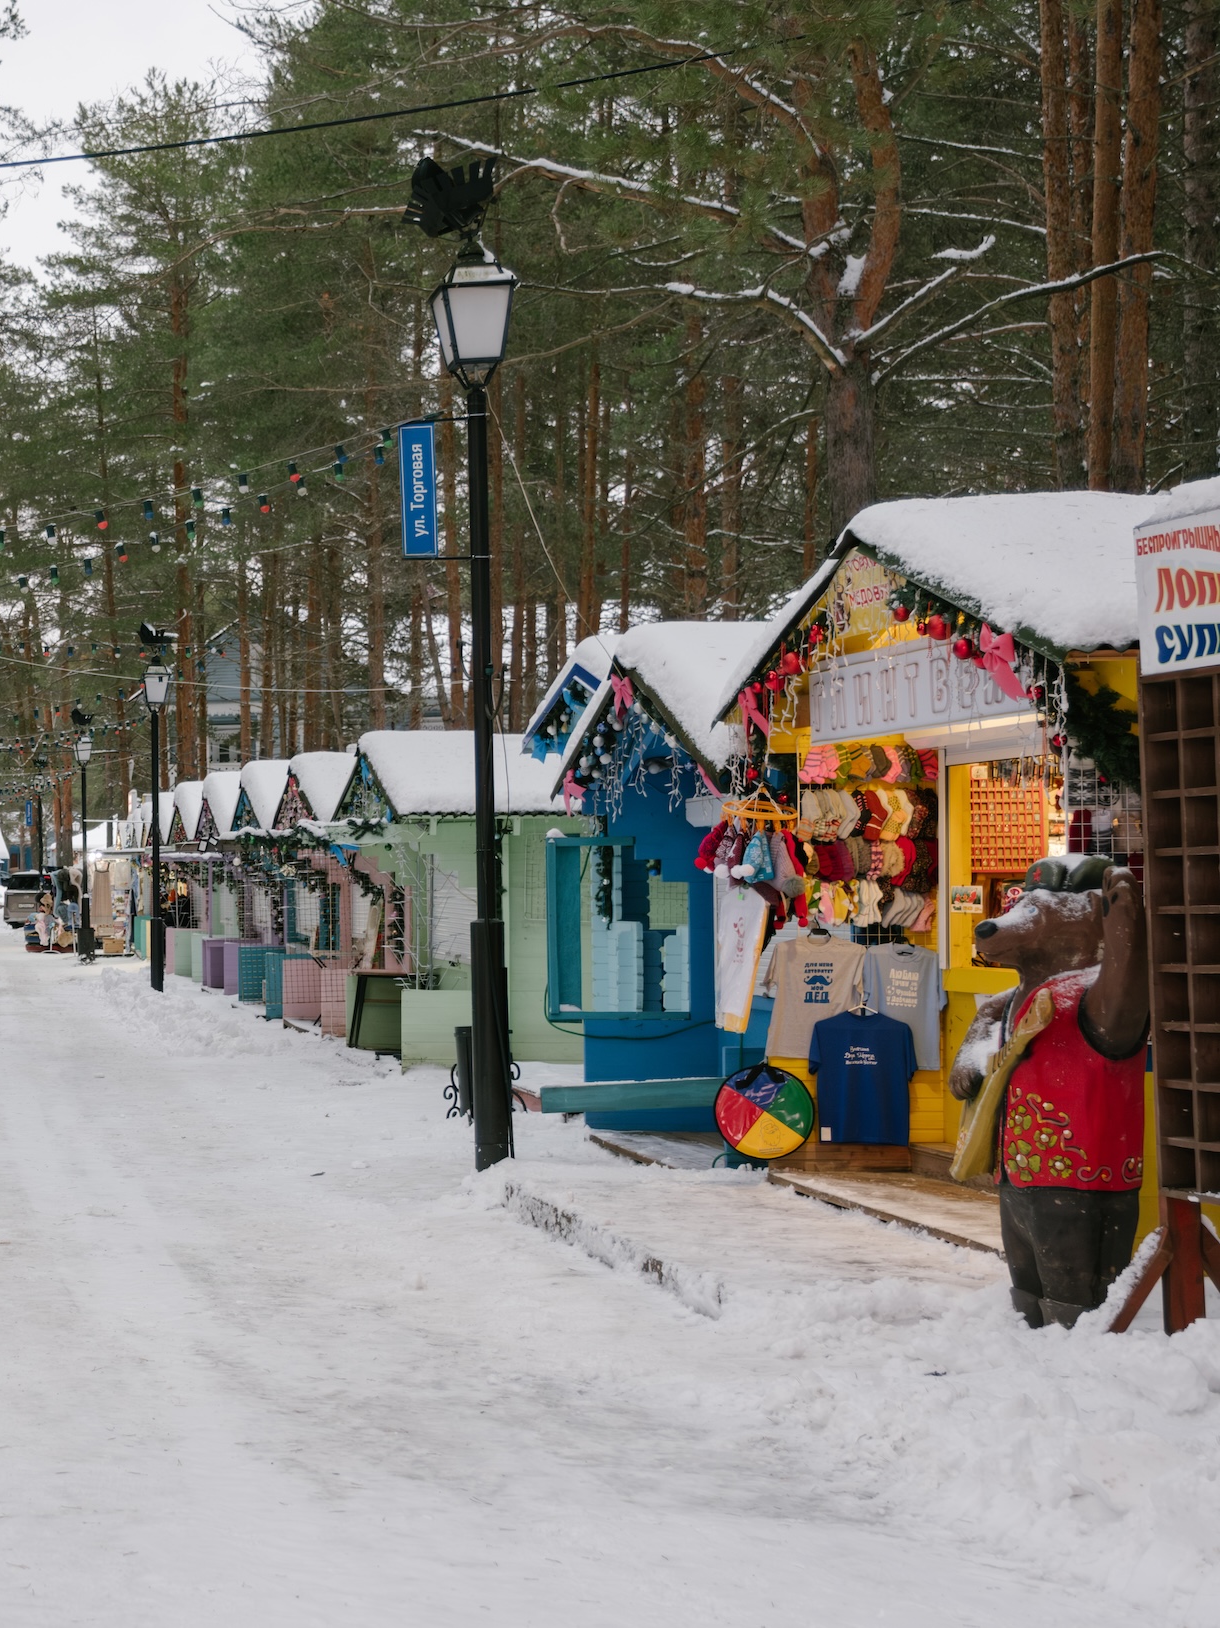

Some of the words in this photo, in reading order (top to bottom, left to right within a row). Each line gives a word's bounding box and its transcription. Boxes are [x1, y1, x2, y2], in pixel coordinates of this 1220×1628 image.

[410, 443, 428, 511] Торговая
[414, 515, 429, 538] ул.
[1154, 567, 1220, 614] ЛОП
[1155, 623, 1220, 665] СУП
[812, 656, 1031, 733] ГЛИНТВЕ
[804, 991, 830, 1004] ДЕД
